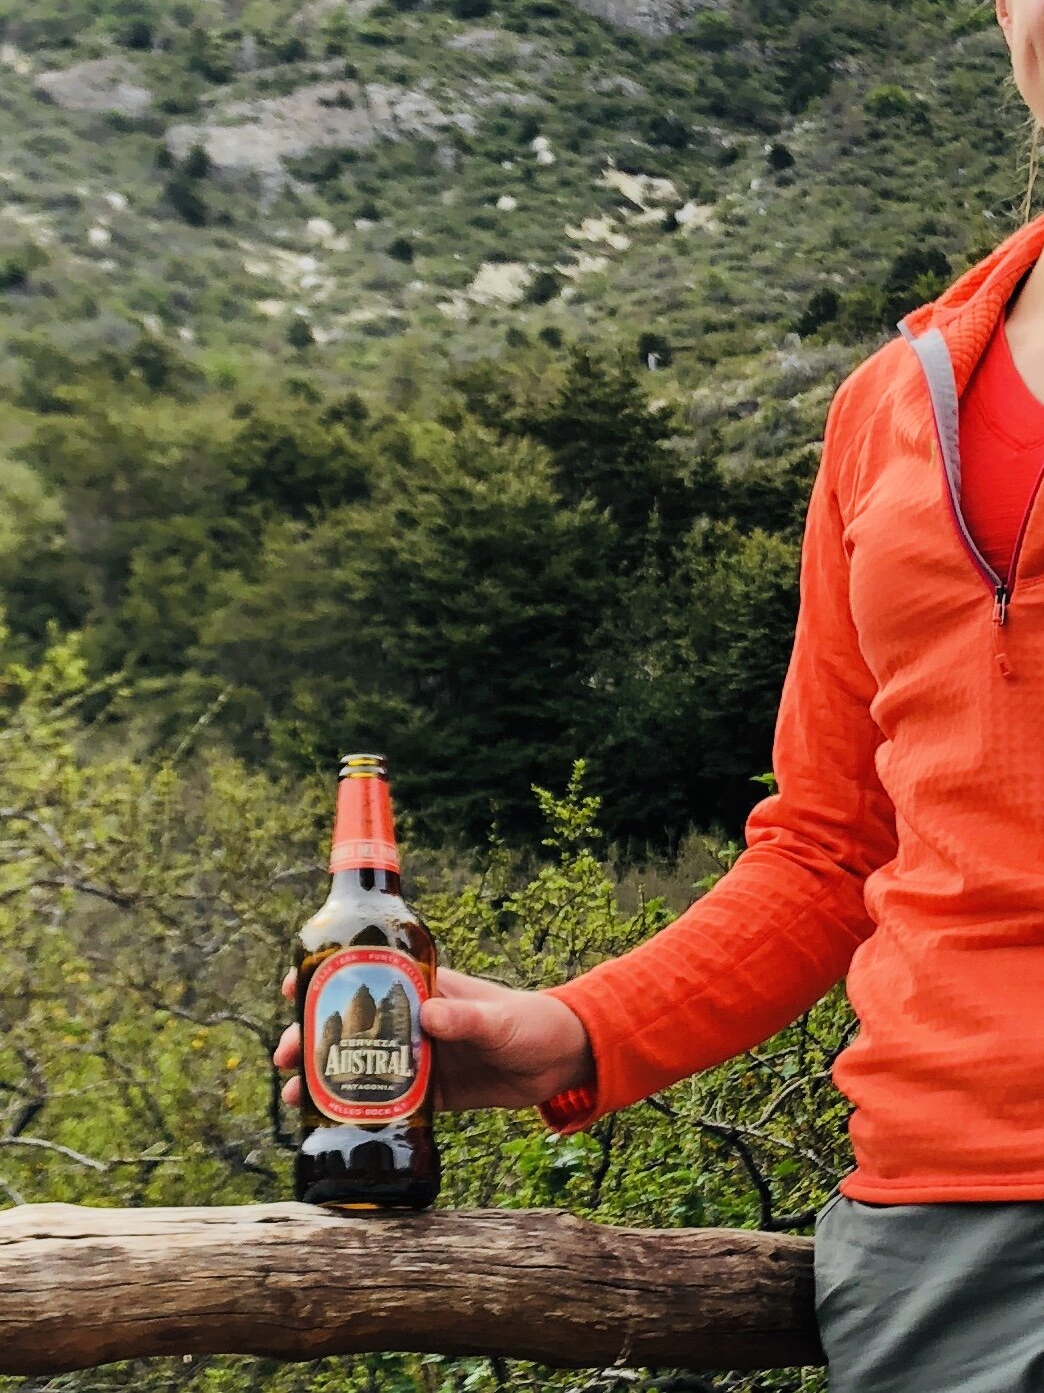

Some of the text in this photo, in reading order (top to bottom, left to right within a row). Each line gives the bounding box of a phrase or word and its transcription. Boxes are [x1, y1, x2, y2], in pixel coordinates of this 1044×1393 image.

[339, 1039, 398, 1047] CERVEZA
[325, 1044, 412, 1076] AUSTRAL
[340, 1083, 395, 1091] PATAGONIA
